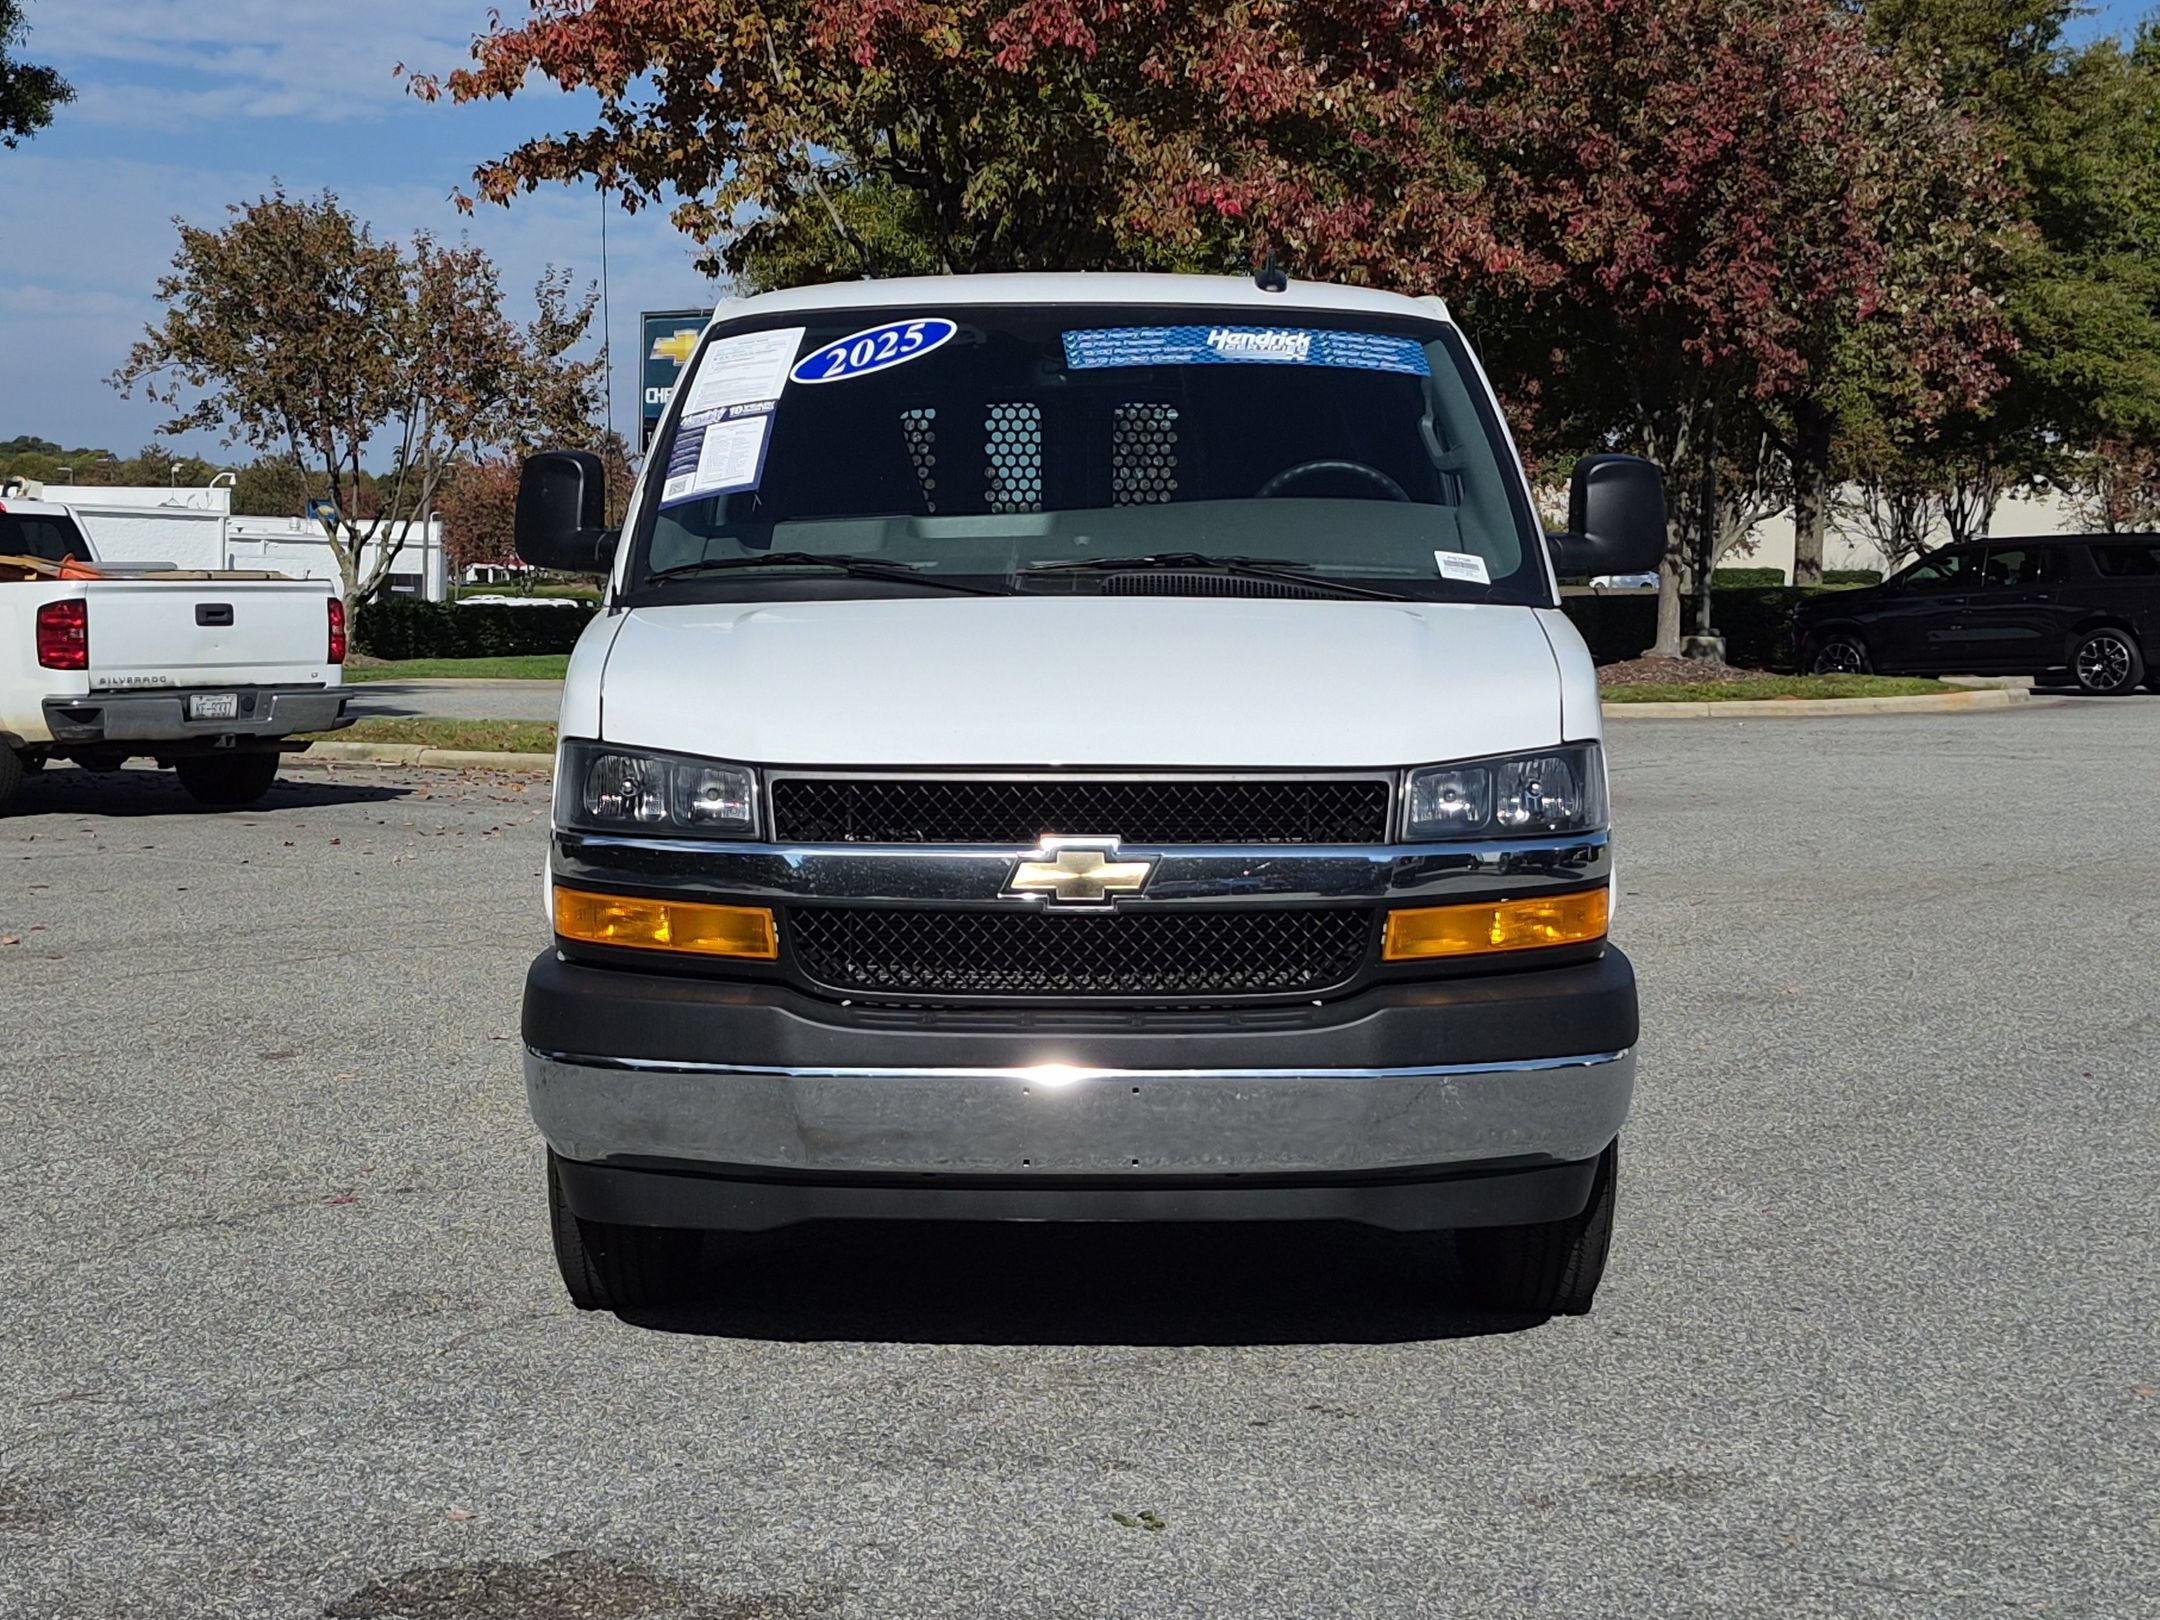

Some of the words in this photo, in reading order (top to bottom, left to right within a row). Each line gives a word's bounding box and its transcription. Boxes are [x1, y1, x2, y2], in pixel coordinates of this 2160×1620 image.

[822, 322, 926, 378] 2025
[1206, 329, 1312, 356] Hendrick
[99, 675, 167, 685] SILVERADO
